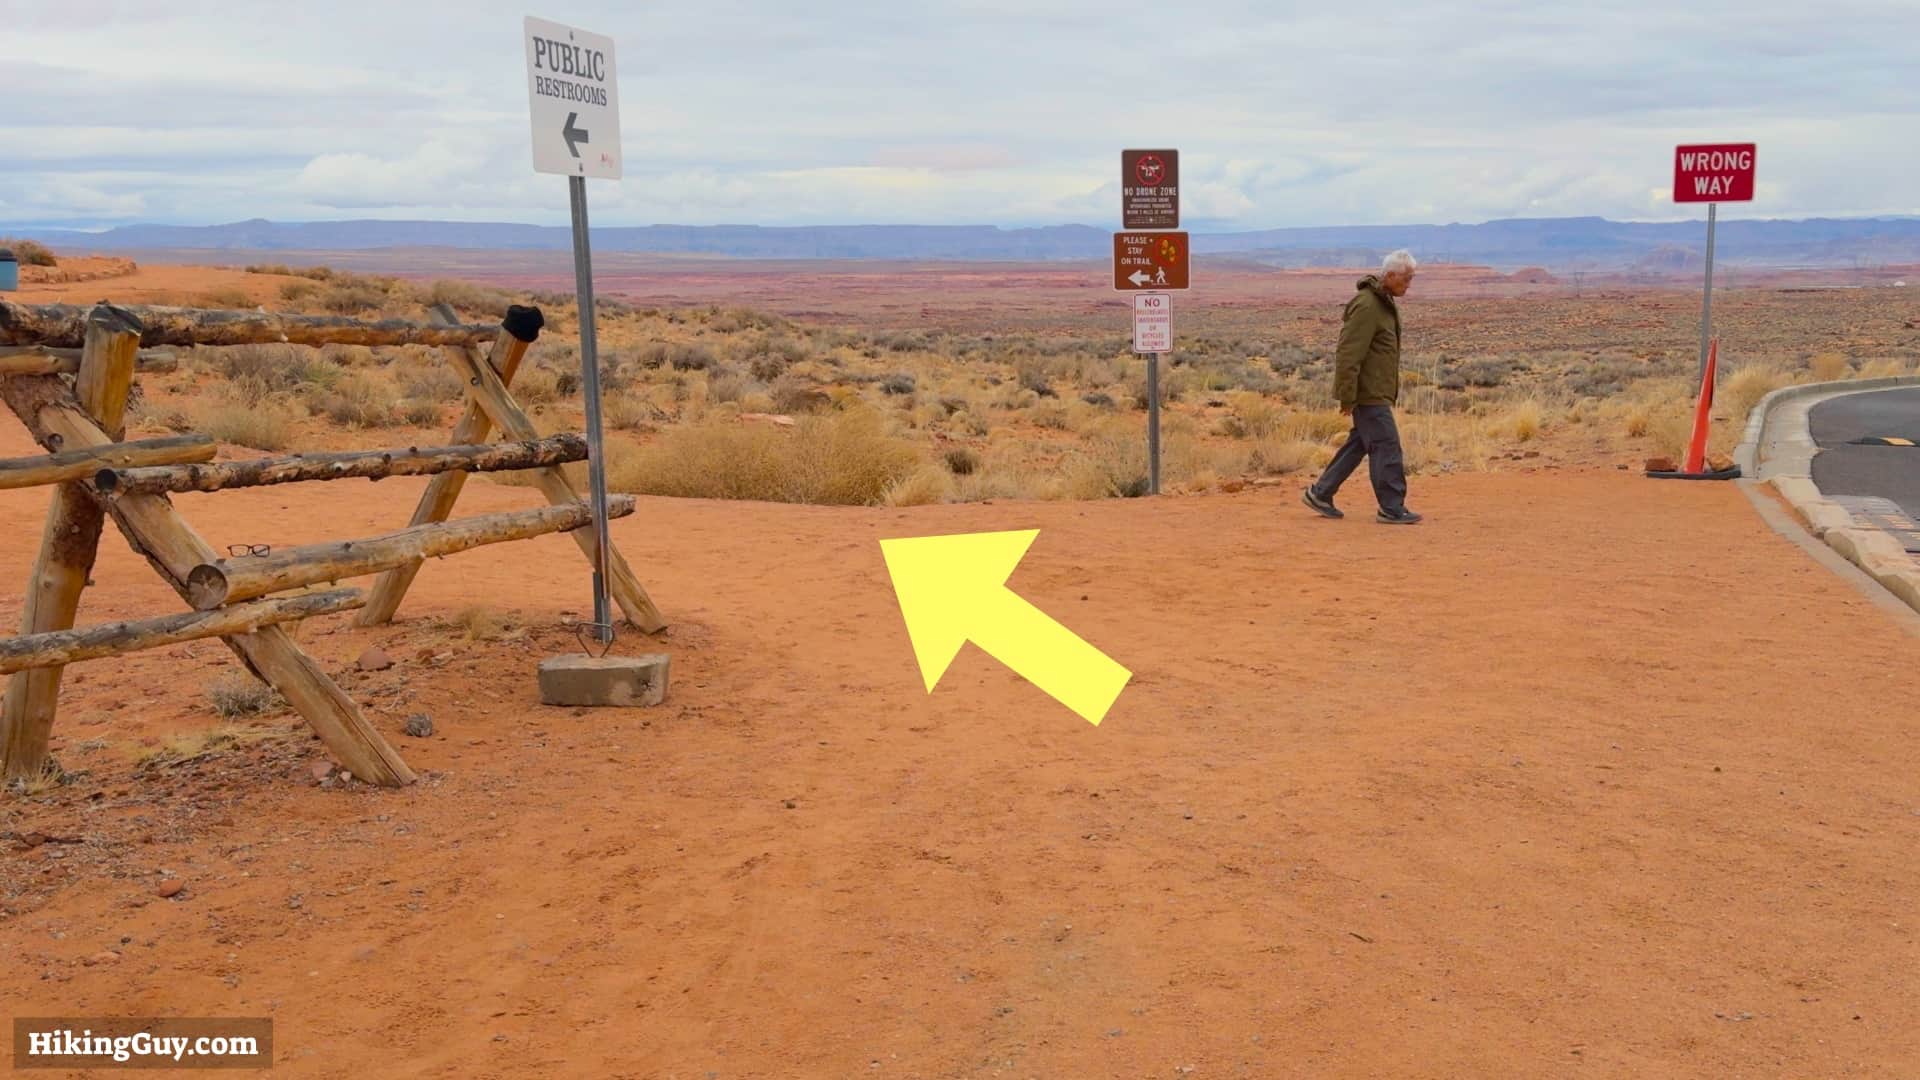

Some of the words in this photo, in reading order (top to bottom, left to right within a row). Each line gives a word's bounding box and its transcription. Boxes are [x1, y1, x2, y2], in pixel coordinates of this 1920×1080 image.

[533, 36, 605, 82] PUBLIC
[535, 75, 607, 107] RESTROOMS
[1680, 151, 1751, 172] WRONG
[1694, 175, 1734, 195] WAY
[1124, 187, 1134, 196] NO
[1136, 187, 1157, 196] DRONE
[1160, 187, 1177, 196] ZONE
[1123, 236, 1148, 245] PLEASE
[1127, 247, 1144, 255] STAY
[1120, 257, 1131, 265] ON
[1133, 257, 1151, 265] TRAIL
[1144, 298, 1160, 307] NO
